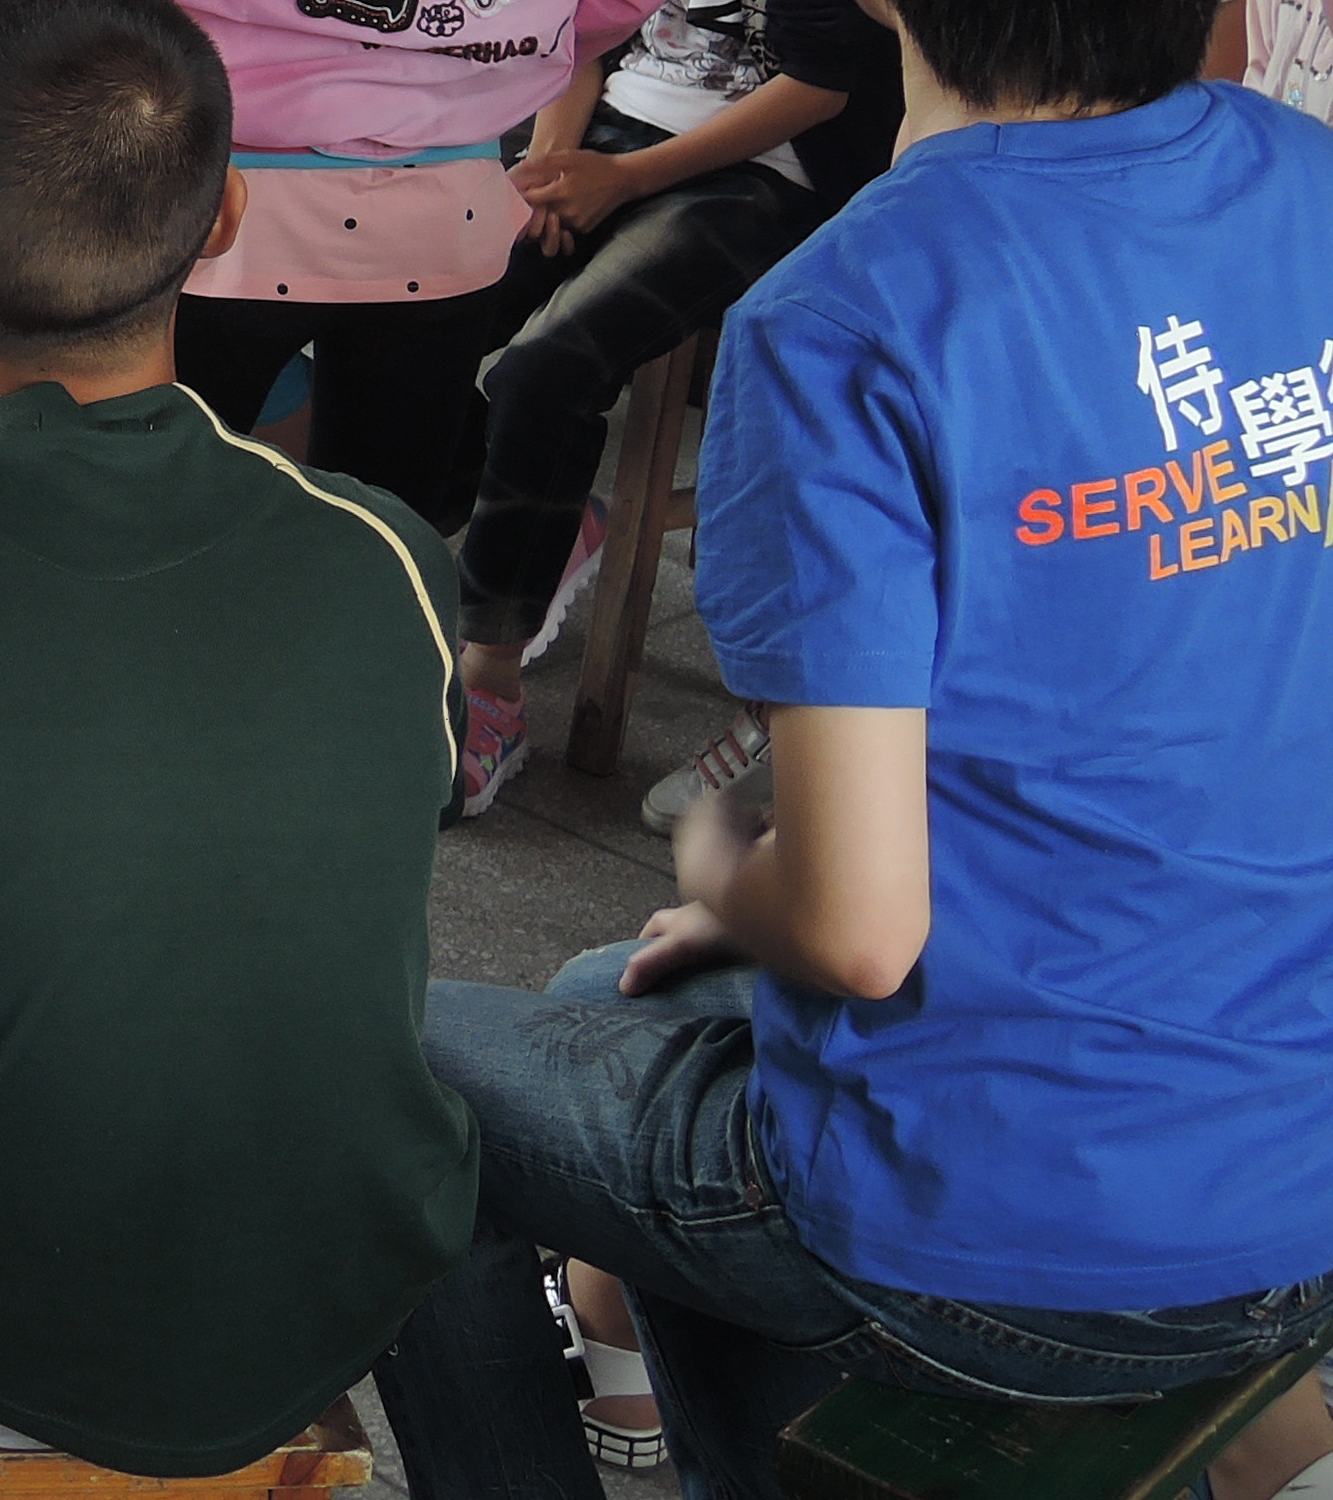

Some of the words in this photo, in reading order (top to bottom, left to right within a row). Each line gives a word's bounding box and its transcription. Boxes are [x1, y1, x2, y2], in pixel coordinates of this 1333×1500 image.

[1137, 315, 1333, 487] 侍學
[1015, 438, 1248, 546] SERVE
[1149, 483, 1322, 581] LEARN
